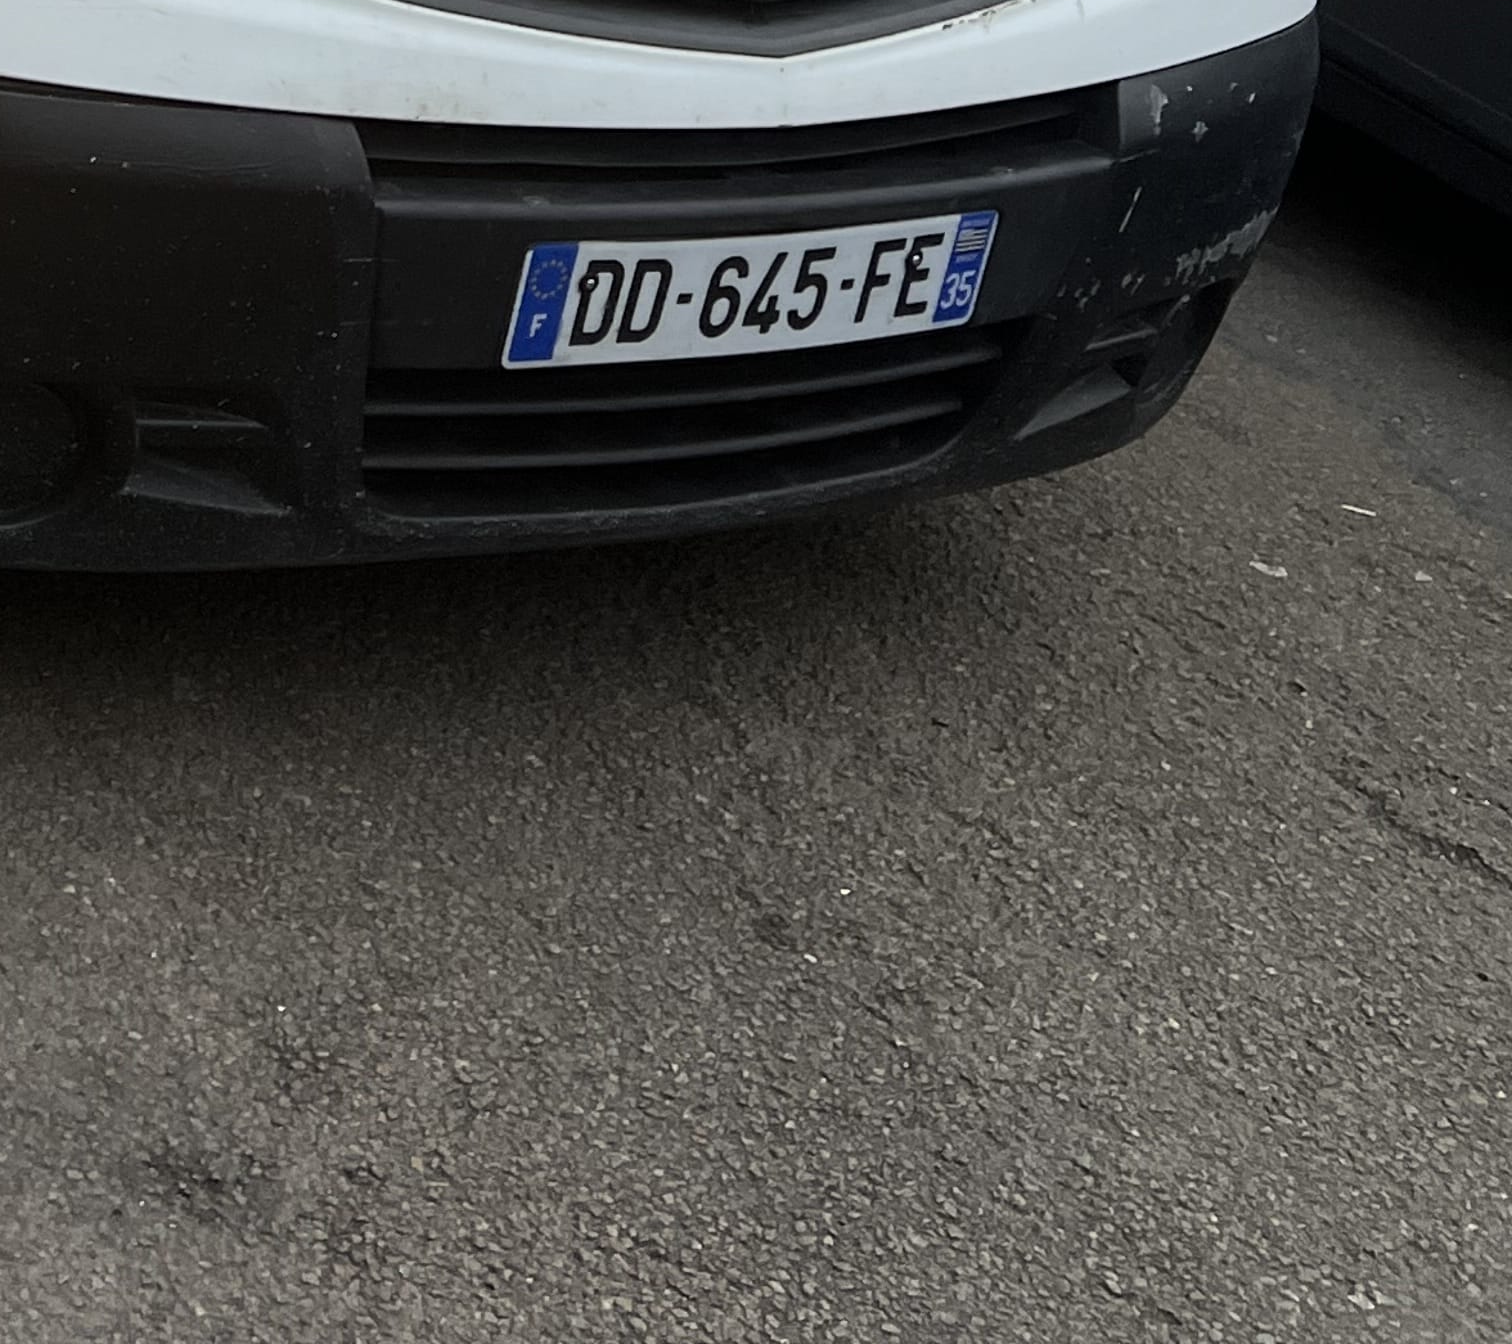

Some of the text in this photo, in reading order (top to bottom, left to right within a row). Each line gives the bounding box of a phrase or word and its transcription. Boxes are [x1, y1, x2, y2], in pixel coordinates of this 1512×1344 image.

[568, 232, 945, 346] DD-645-FE
[940, 270, 977, 310] 35
[529, 313, 548, 338] F
